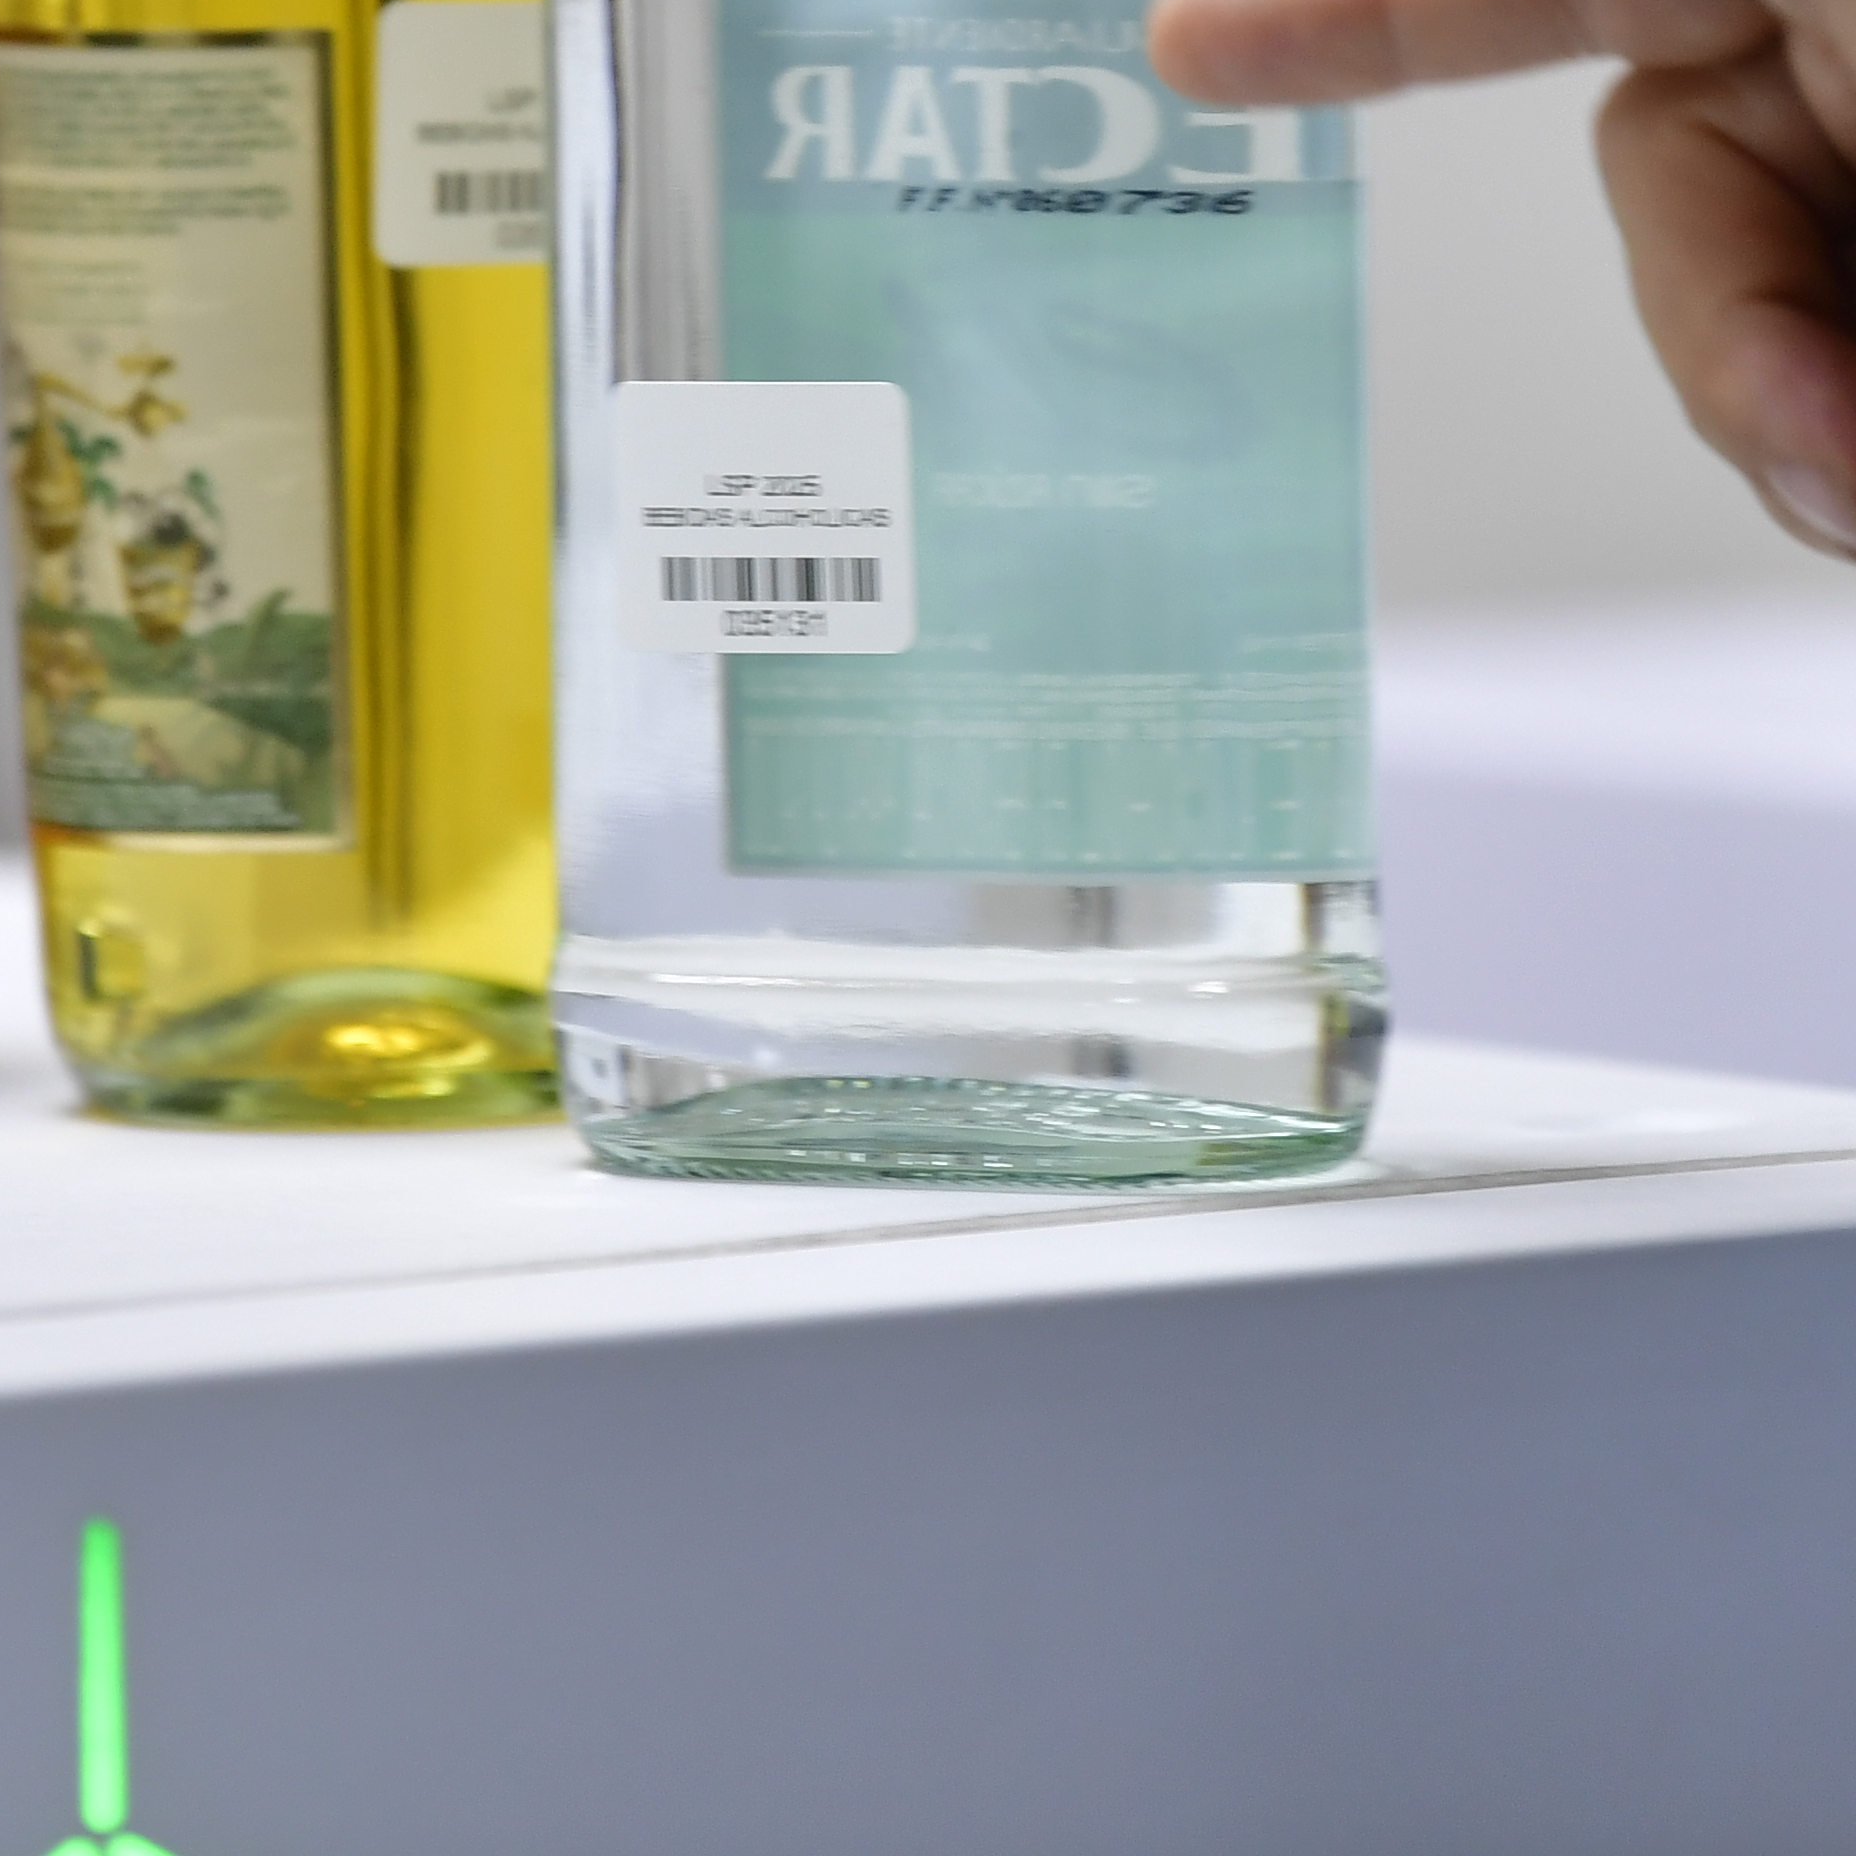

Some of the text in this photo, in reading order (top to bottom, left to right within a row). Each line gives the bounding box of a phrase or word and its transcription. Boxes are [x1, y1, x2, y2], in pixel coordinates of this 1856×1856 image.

[704, 473, 822, 496] LSP 2025
[642, 506, 737, 528] BEBIDAS
